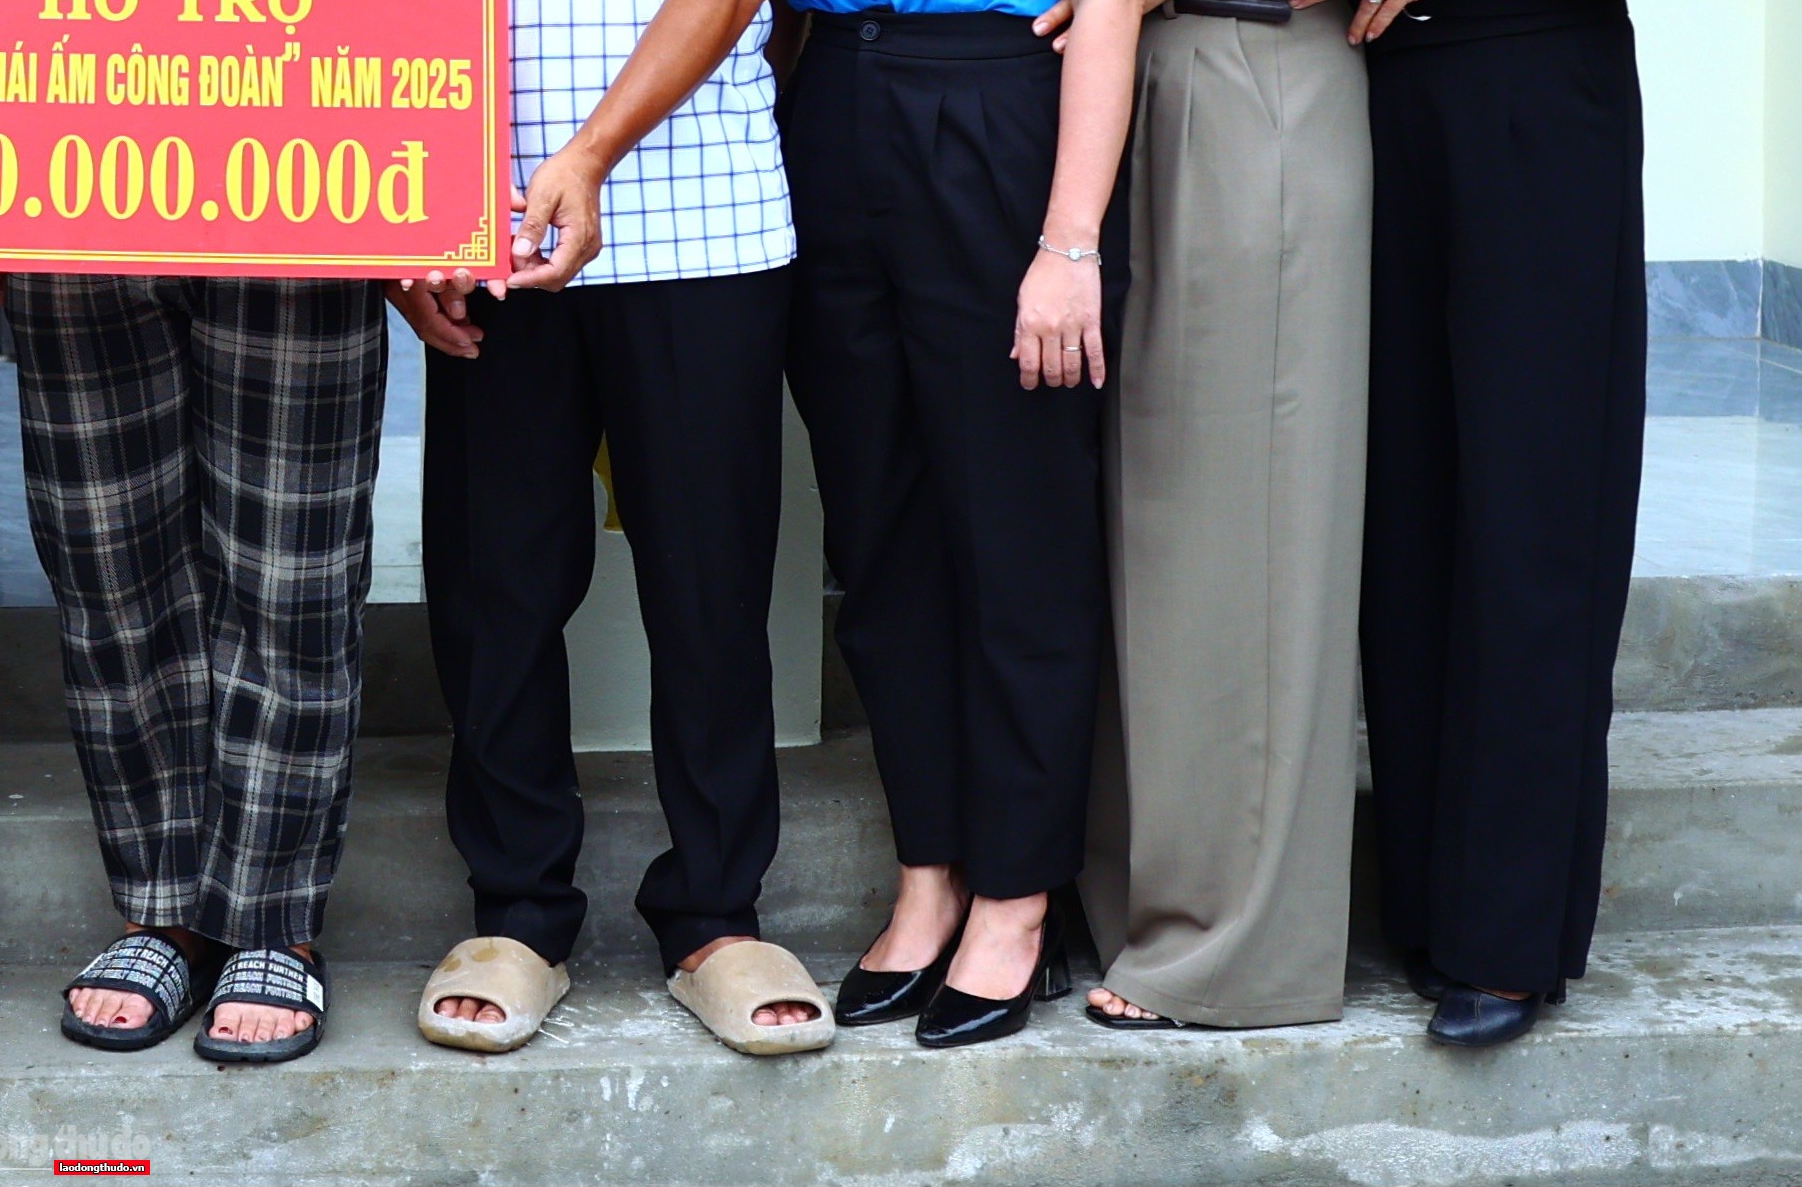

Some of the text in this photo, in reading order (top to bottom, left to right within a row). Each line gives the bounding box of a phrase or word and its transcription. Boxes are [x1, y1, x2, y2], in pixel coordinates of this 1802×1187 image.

[46, 34, 96, 104] ẤM
[106, 43, 190, 106] CÔNG
[198, 42, 301, 107] ĐOÀN”
[311, 46, 382, 108] NĂM
[391, 57, 474, 110] 2025
[141, 947, 170, 968] REACH
[237, 960, 266, 970] REACH
[268, 963, 304, 983] FURTHER
